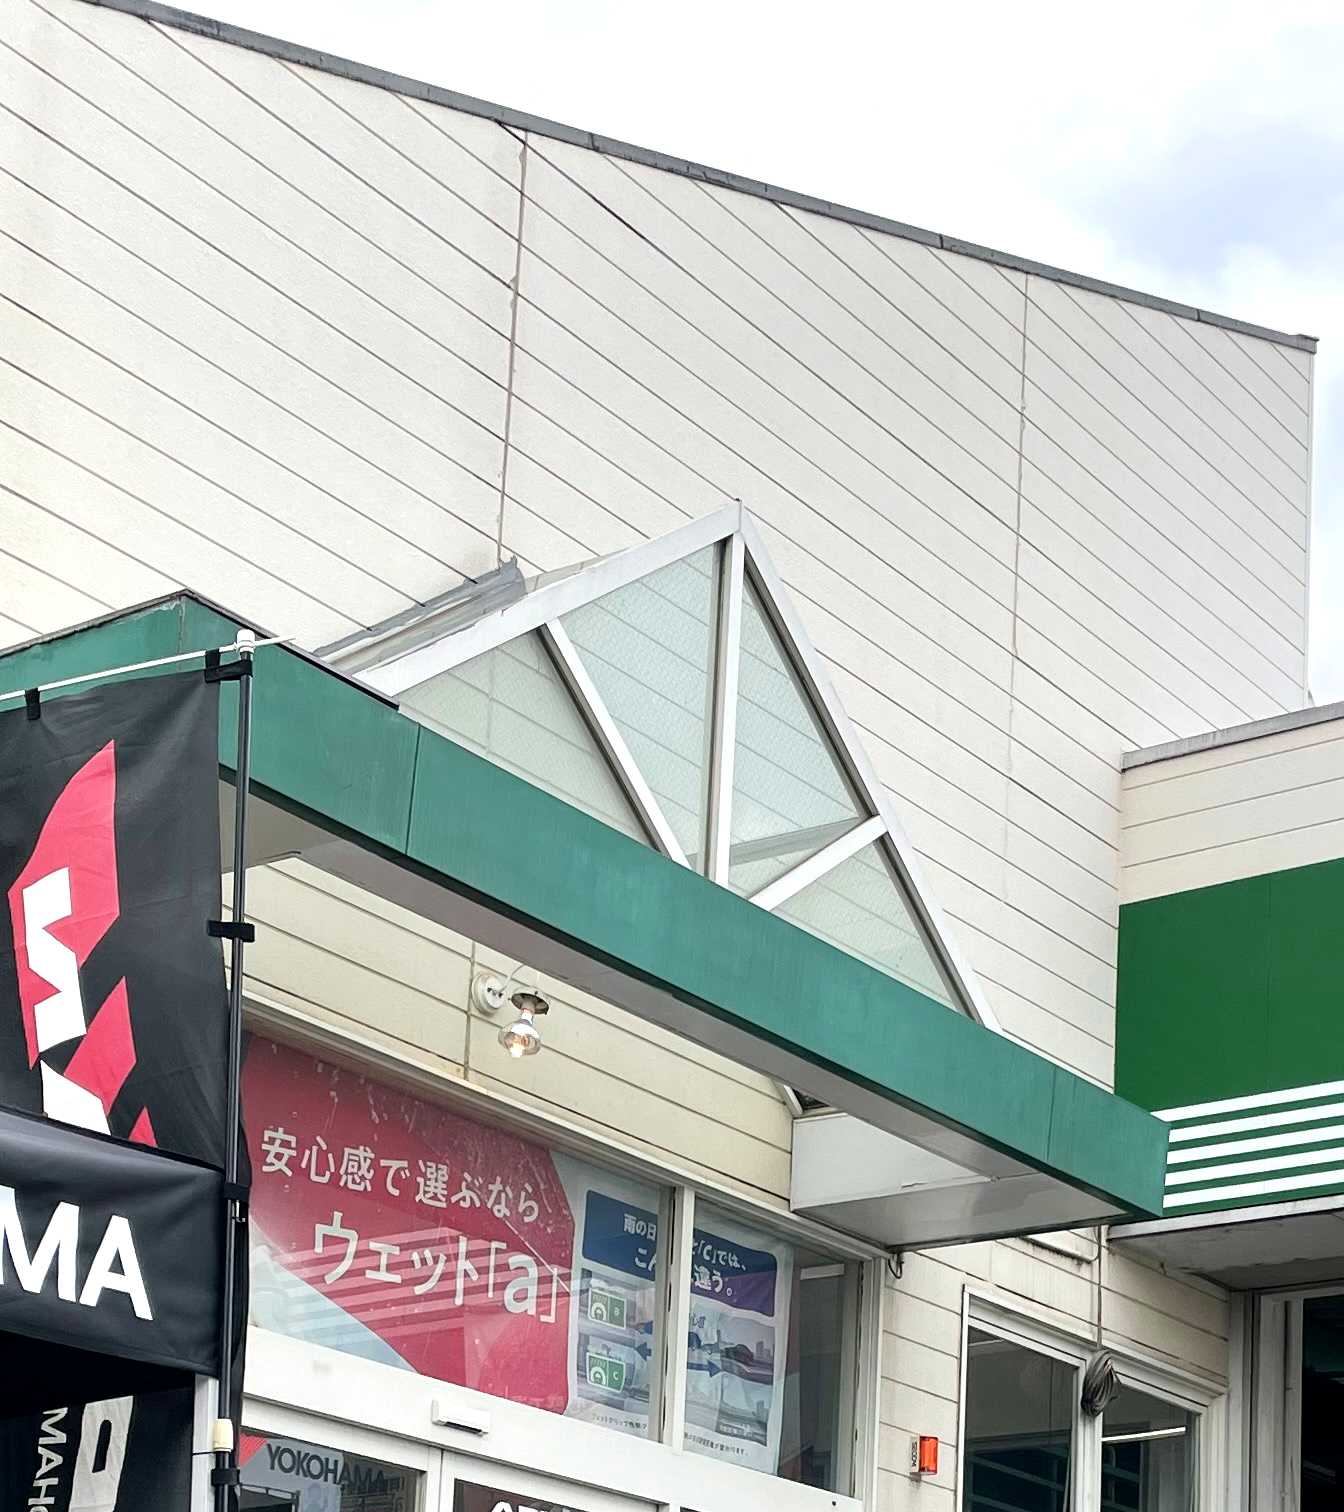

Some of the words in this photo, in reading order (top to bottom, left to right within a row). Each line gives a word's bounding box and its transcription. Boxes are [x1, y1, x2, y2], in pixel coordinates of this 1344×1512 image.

[261, 1127, 539, 1222] 安心感で選ぶなら
[314, 1211, 558, 1324] ウェット「a」
